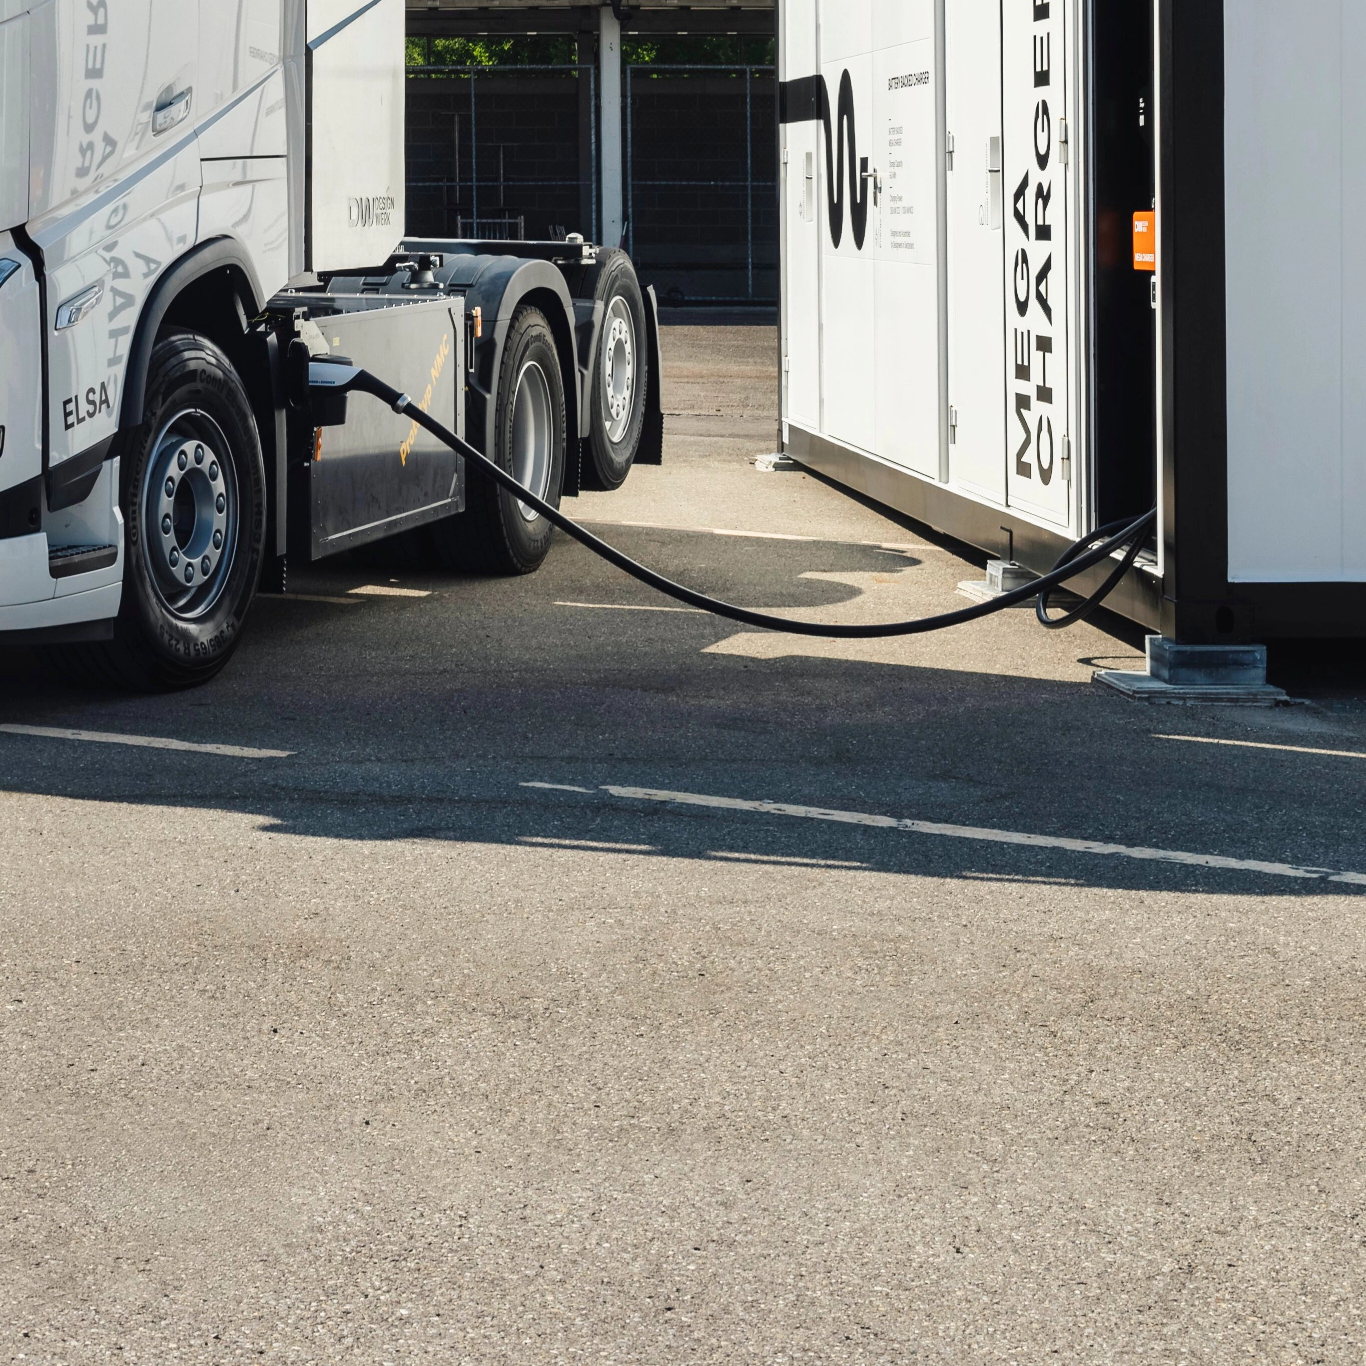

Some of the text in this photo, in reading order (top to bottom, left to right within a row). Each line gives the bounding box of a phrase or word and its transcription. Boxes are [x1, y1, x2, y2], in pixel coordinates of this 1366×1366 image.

[375, 196, 395, 211] DESIGN
[1013, 169, 1032, 480] MEGA
[430, 333, 450, 387] NMC
[198, 367, 225, 395] Conti
[62, 381, 110, 432] ELSA
[193, 629, 228, 657] 385/65
